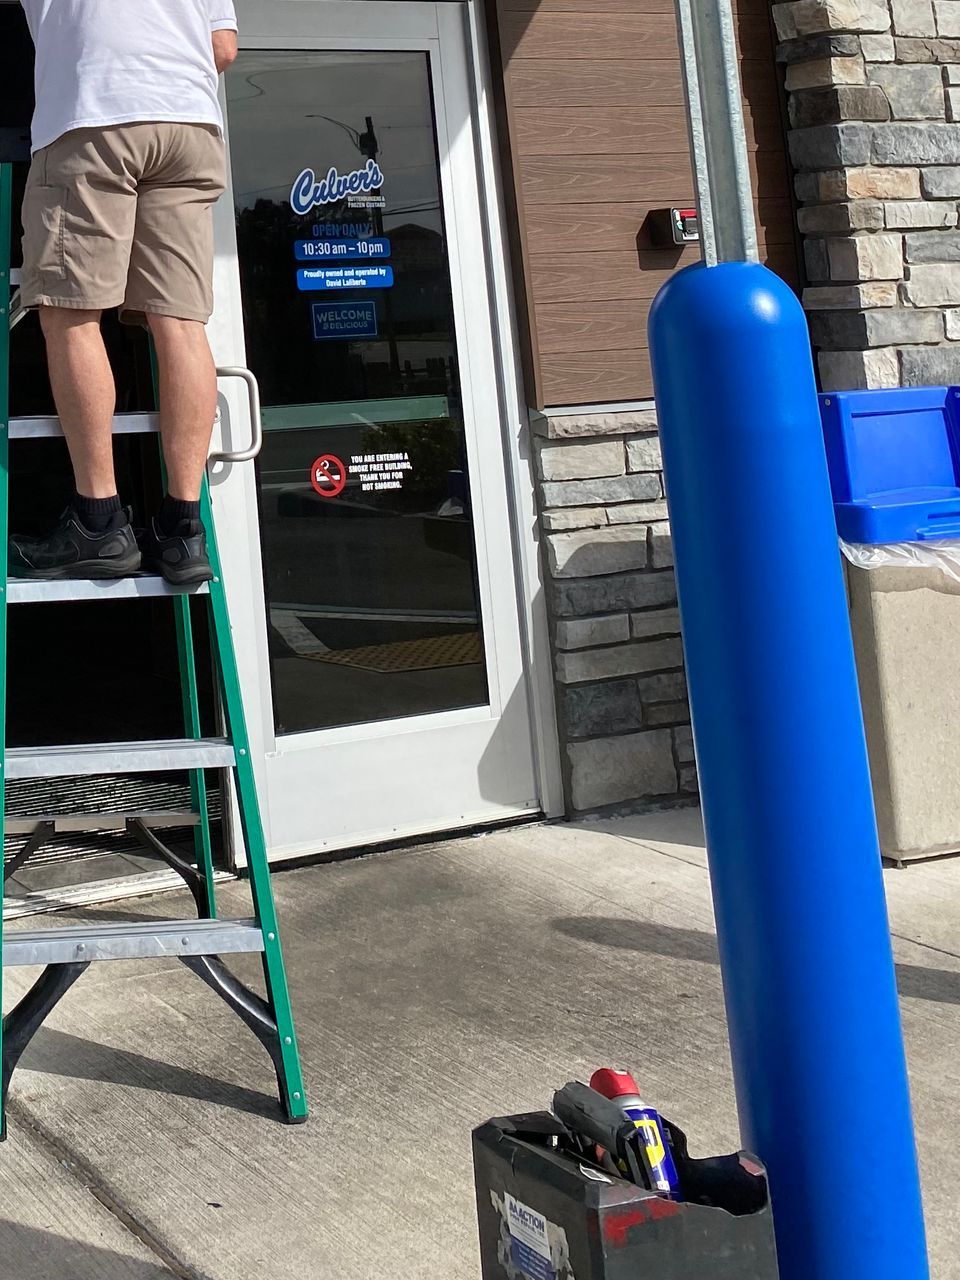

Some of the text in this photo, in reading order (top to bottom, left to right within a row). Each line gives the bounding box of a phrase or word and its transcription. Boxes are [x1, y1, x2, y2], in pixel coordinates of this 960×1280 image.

[290, 158, 384, 215] Culver's
[312, 223, 370, 237] OPEN DAILY
[302, 242, 331, 255] 10:30
[332, 243, 347, 254] am
[356, 241, 368, 254] 10
[368, 243, 383, 256] pm
[303, 267, 386, 279] Proudly owned and operated by
[326, 279, 342, 287] David
[316, 310, 372, 323] WELCOME
[329, 321, 368, 330] DELICIOUS
[350, 452, 409, 464] YOU ARE ENTERING A
[348, 464, 369, 473] SMOKE
[369, 463, 384, 471] FREE
[359, 471, 403, 482] THANK YOU FOR
[361, 482, 373, 491] NOT
